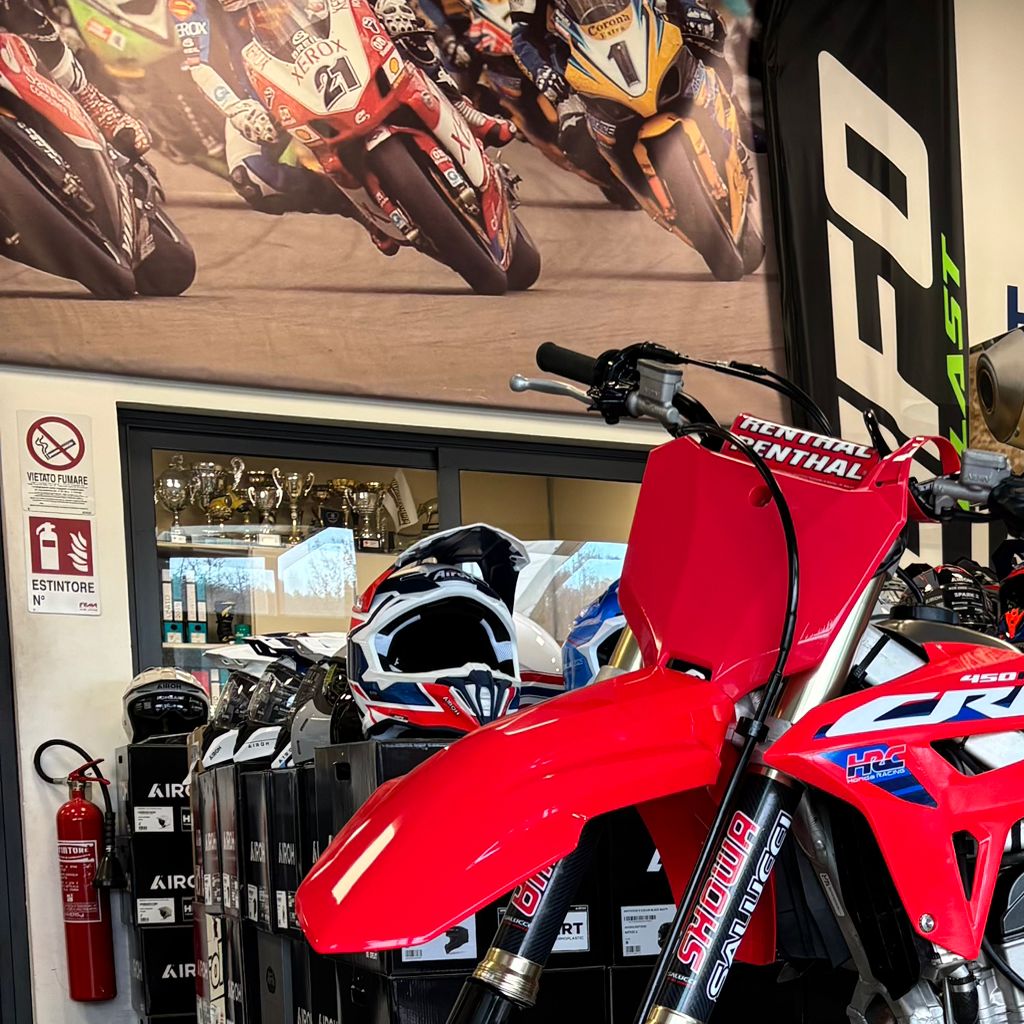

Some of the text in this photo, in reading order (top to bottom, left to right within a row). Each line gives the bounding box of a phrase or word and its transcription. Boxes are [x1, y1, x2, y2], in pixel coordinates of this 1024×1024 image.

[588, 14, 630, 37] Corona
[291, 38, 348, 85] XEROX
[608, 41, 640, 87] 1
[313, 55, 361, 111] 21
[740, 416, 872, 459] RENTHAL
[731, 435, 863, 481] RENTHAL
[27, 472, 89, 486] VIETATO FUMARE
[32, 579, 95, 594] ESTINTORE
[846, 743, 907, 780] HRC
[876, 768, 906, 779] RACING
[278, 841, 295, 866] AIROH
[677, 810, 761, 975] SHOWA
[561, 922, 584, 935] RT
[162, 963, 196, 979] AIR
